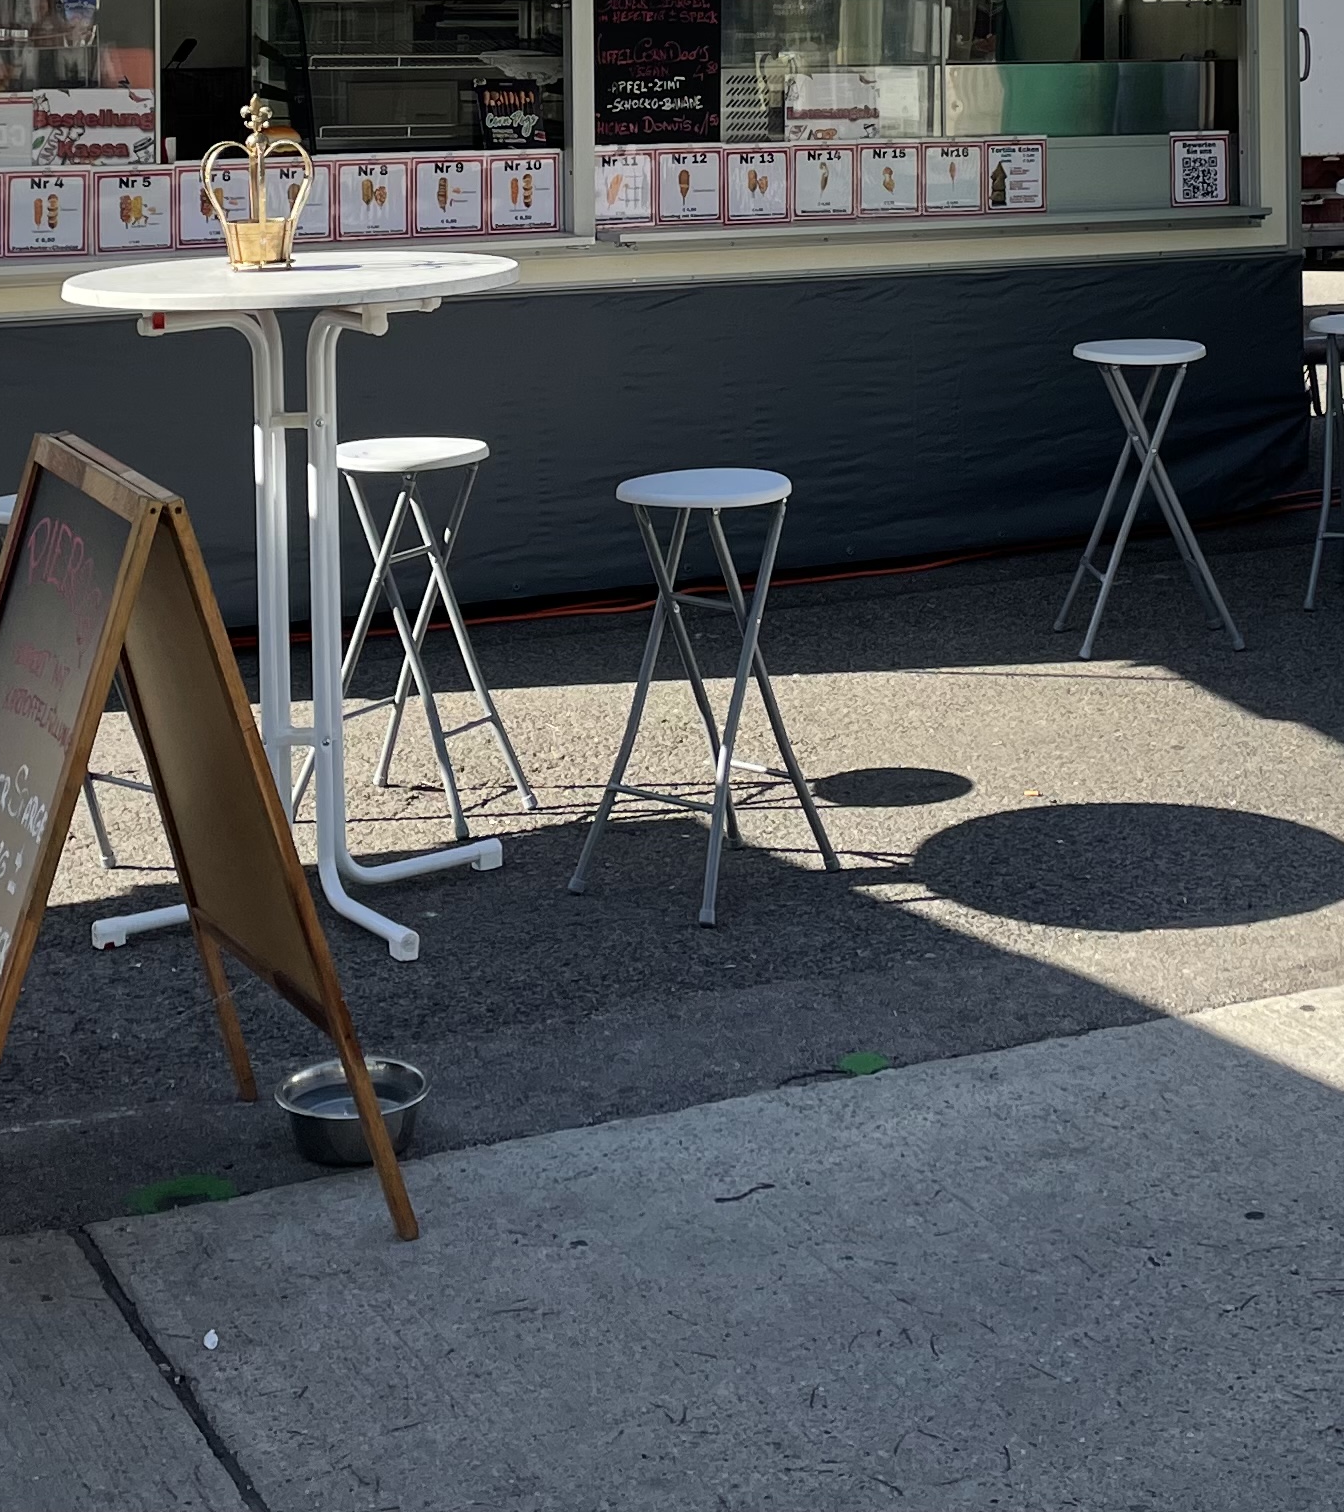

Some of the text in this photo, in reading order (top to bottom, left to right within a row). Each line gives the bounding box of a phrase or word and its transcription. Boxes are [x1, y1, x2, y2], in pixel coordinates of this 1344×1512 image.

[33, 108, 154, 131] Bestellung
[57, 140, 130, 159] Kassa
[873, 148, 907, 159] Nr 15
[602, 156, 618, 167] Nr
[672, 153, 707, 164] Nr 12
[740, 153, 774, 164] Nr 13
[808, 151, 824, 161] Nr
[358, 164, 389, 177] Nr 8
[434, 161, 465, 174] Nr 9
[504, 159, 542, 172] Nr 10
[30, 177, 65, 189] Nr 4
[118, 177, 152, 188] Nr 5
